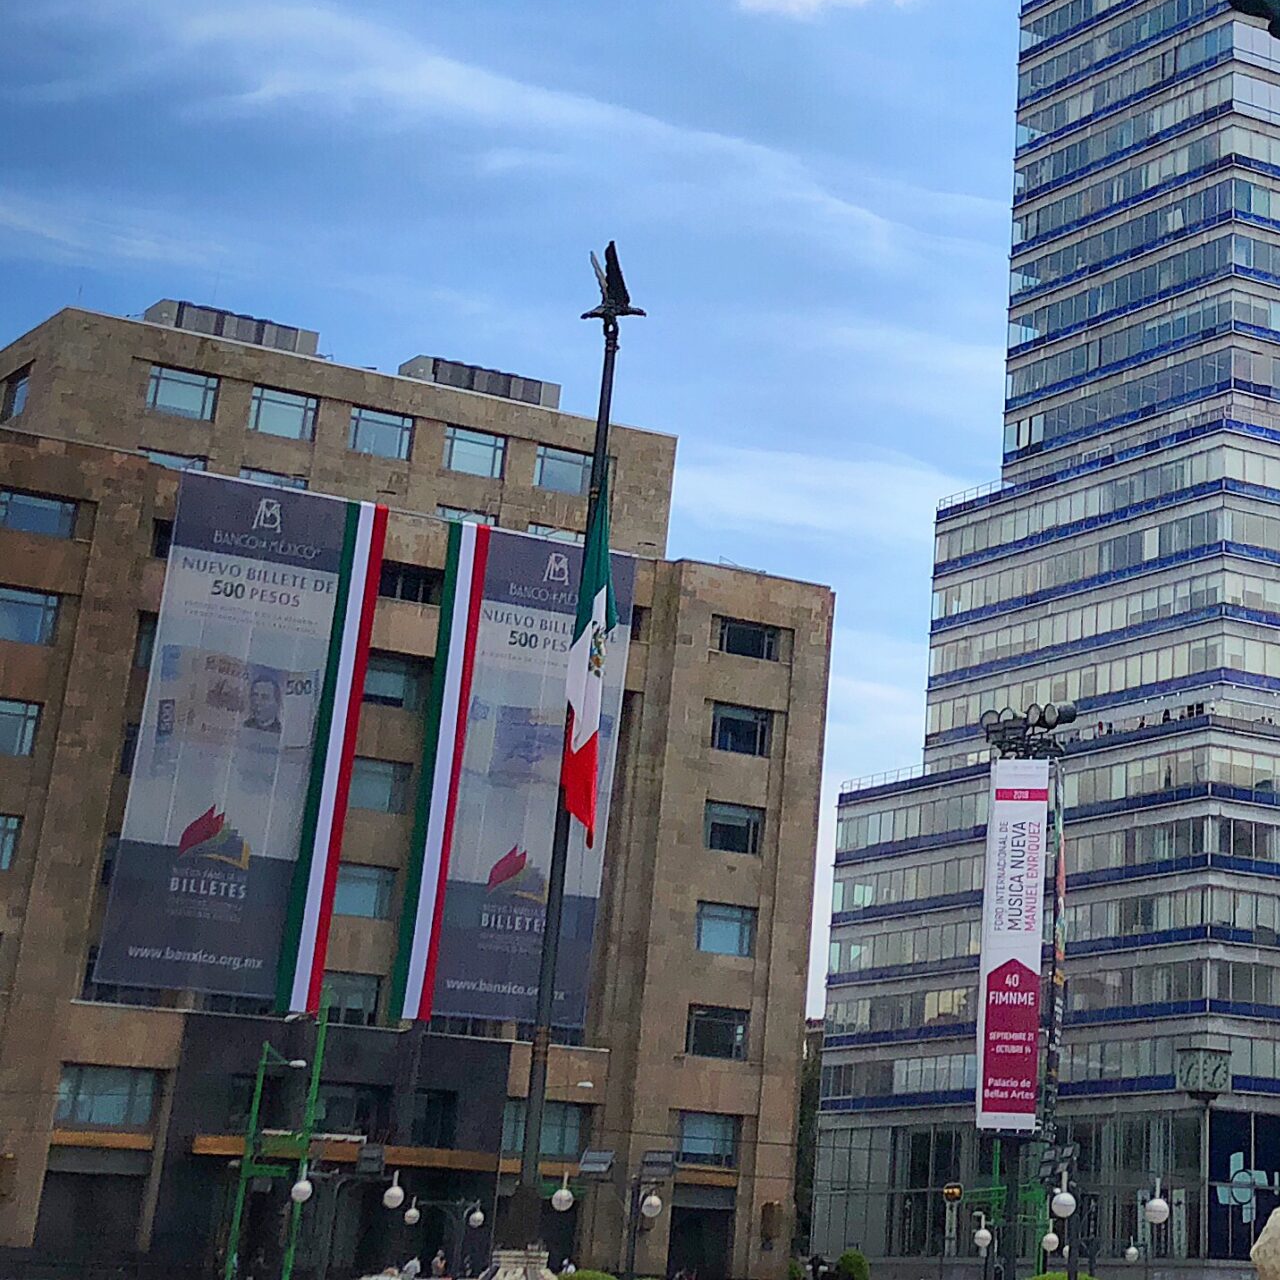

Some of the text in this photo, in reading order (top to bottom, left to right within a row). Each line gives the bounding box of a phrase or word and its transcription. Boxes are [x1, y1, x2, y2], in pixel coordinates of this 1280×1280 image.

[213, 529, 259, 549] BANCO
[182, 556, 334, 594] NUEVO BILLETE DE
[210, 579, 301, 608] 500 PESOS
[509, 582, 549, 601] BANCO
[483, 607, 534, 629] NUEVO
[508, 630, 539, 649] 500
[285, 680, 312, 696] 500
[1011, 822, 1026, 869] NUEVA
[994, 821, 1008, 931] FORO INTERNACIONAL DE
[170, 877, 246, 898] BILLETES
[1024, 882, 1038, 931] MANUEL
[128, 946, 263, 970] www.banxico.org.mx
[1005, 973, 1020, 988] 40
[989, 991, 1035, 1007] FIMNME
[989, 1032, 1034, 1042] SEPTIEMBRE 21
[996, 1045, 1023, 1054] OCTUBRE
[988, 1077, 1032, 1088] Palacio de
[984, 1088, 1035, 1100] Bellas Artes
